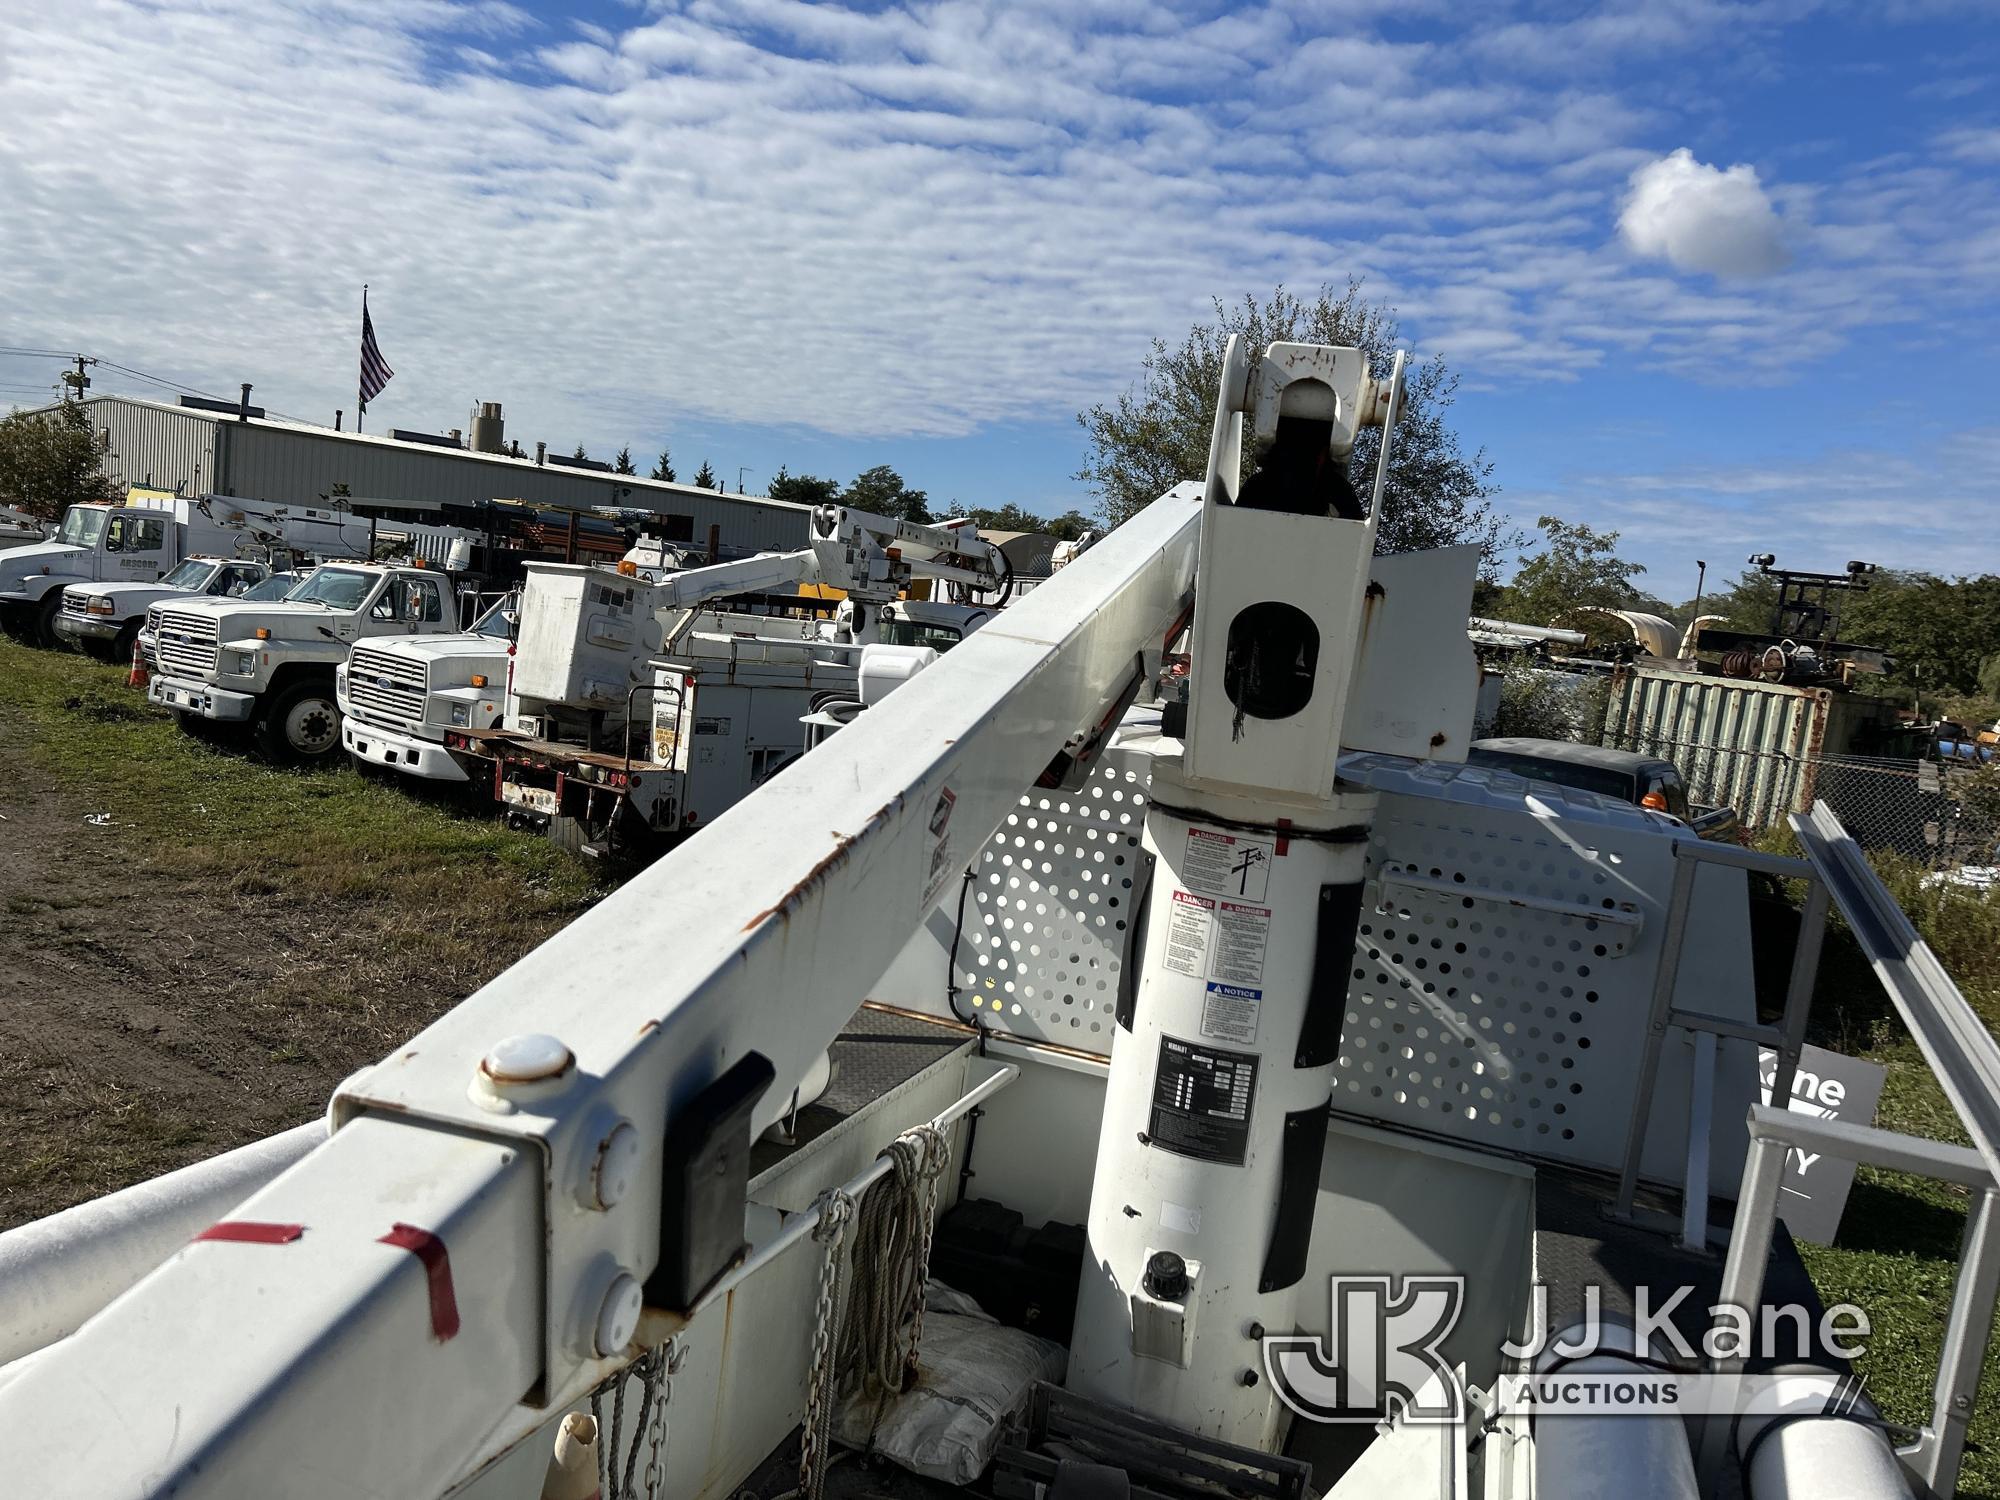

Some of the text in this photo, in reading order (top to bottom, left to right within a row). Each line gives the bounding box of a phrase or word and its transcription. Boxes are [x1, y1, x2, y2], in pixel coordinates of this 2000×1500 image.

[1200, 831, 1227, 844] DANGER
[1183, 892, 1213, 908] DANGER
[1235, 904, 1266, 916] DANGER
[1224, 987, 1256, 998] NOTICE
